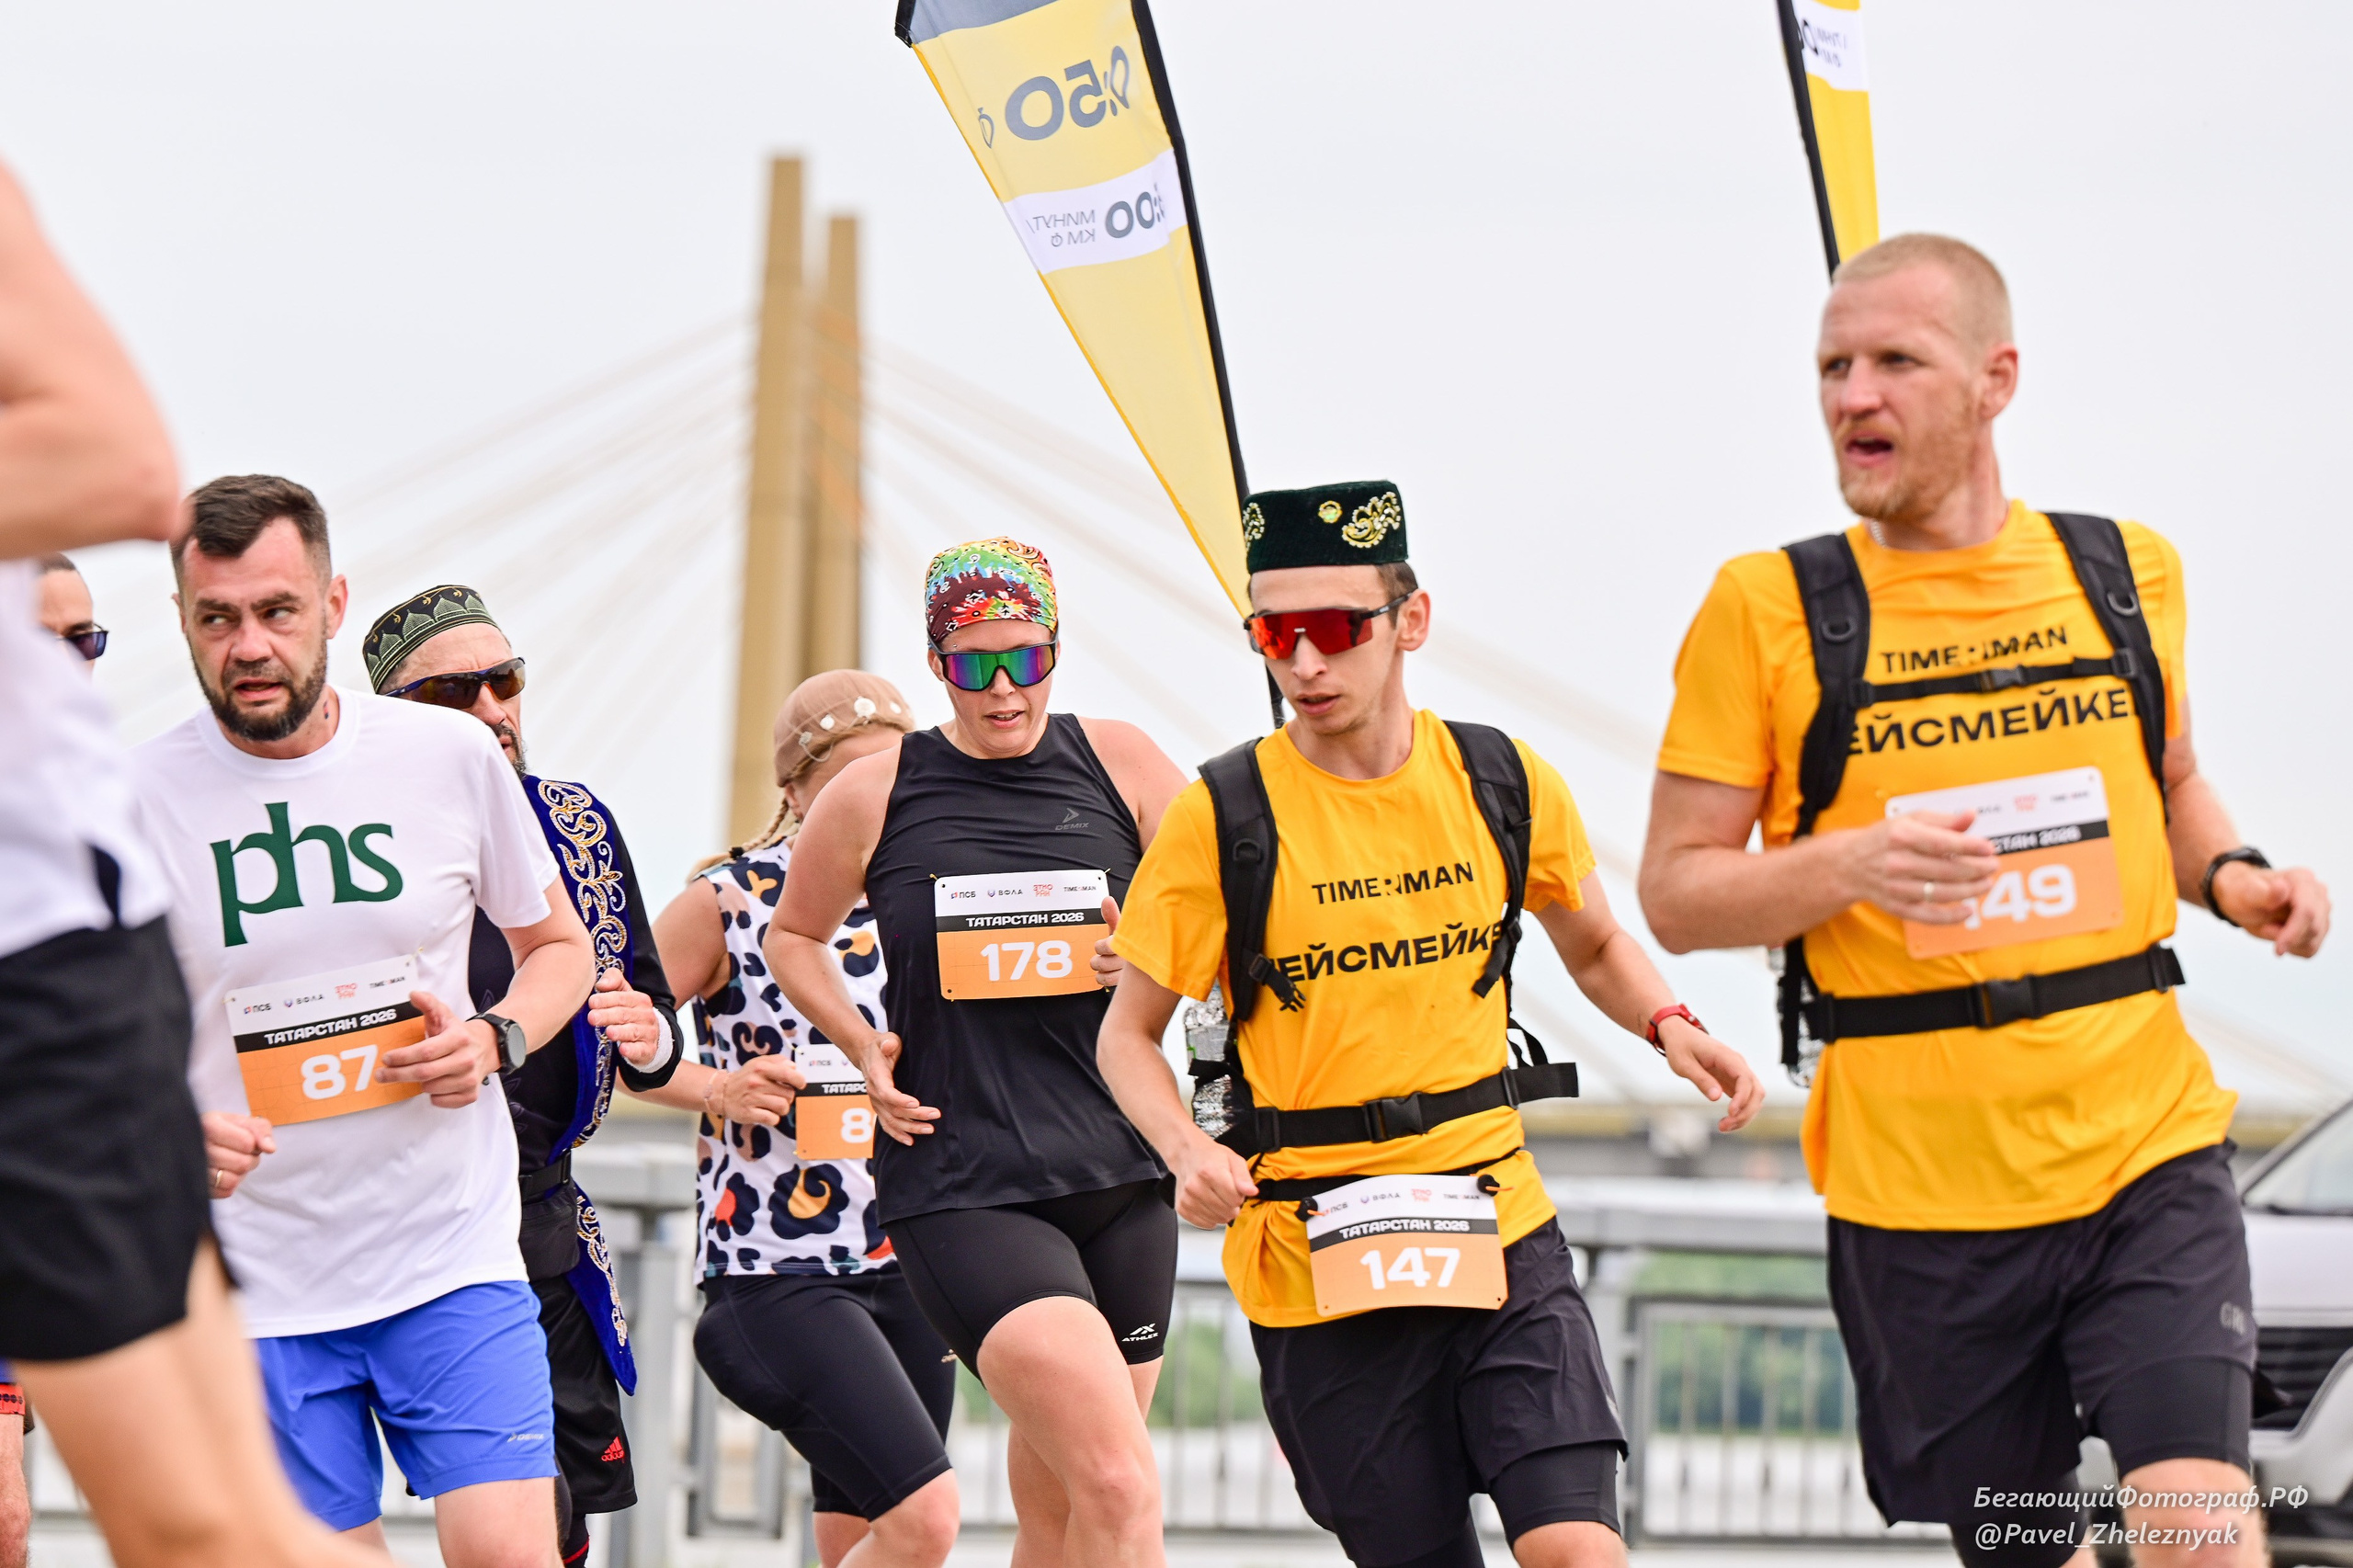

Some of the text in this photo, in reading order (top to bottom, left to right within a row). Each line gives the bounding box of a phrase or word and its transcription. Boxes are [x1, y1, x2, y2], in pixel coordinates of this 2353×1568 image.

[1054, 823, 1090, 831] DEMIX
[210, 801, 404, 948] phs
[959, 891, 976, 899] ПСБ
[966, 912, 1085, 927] ТАТАРСТАН 2026
[980, 939, 1074, 982] 178
[253, 1003, 272, 1014] ПСБ
[264, 1007, 397, 1046] ТАТАРСТАН 2026
[301, 1044, 379, 1100] 87
[840, 1107, 872, 1143] 8
[1339, 1218, 1471, 1240] ТАТАРСТАН 2026
[1359, 1246, 1461, 1290] 147
[1121, 1332, 1159, 1342] ATHLEX
